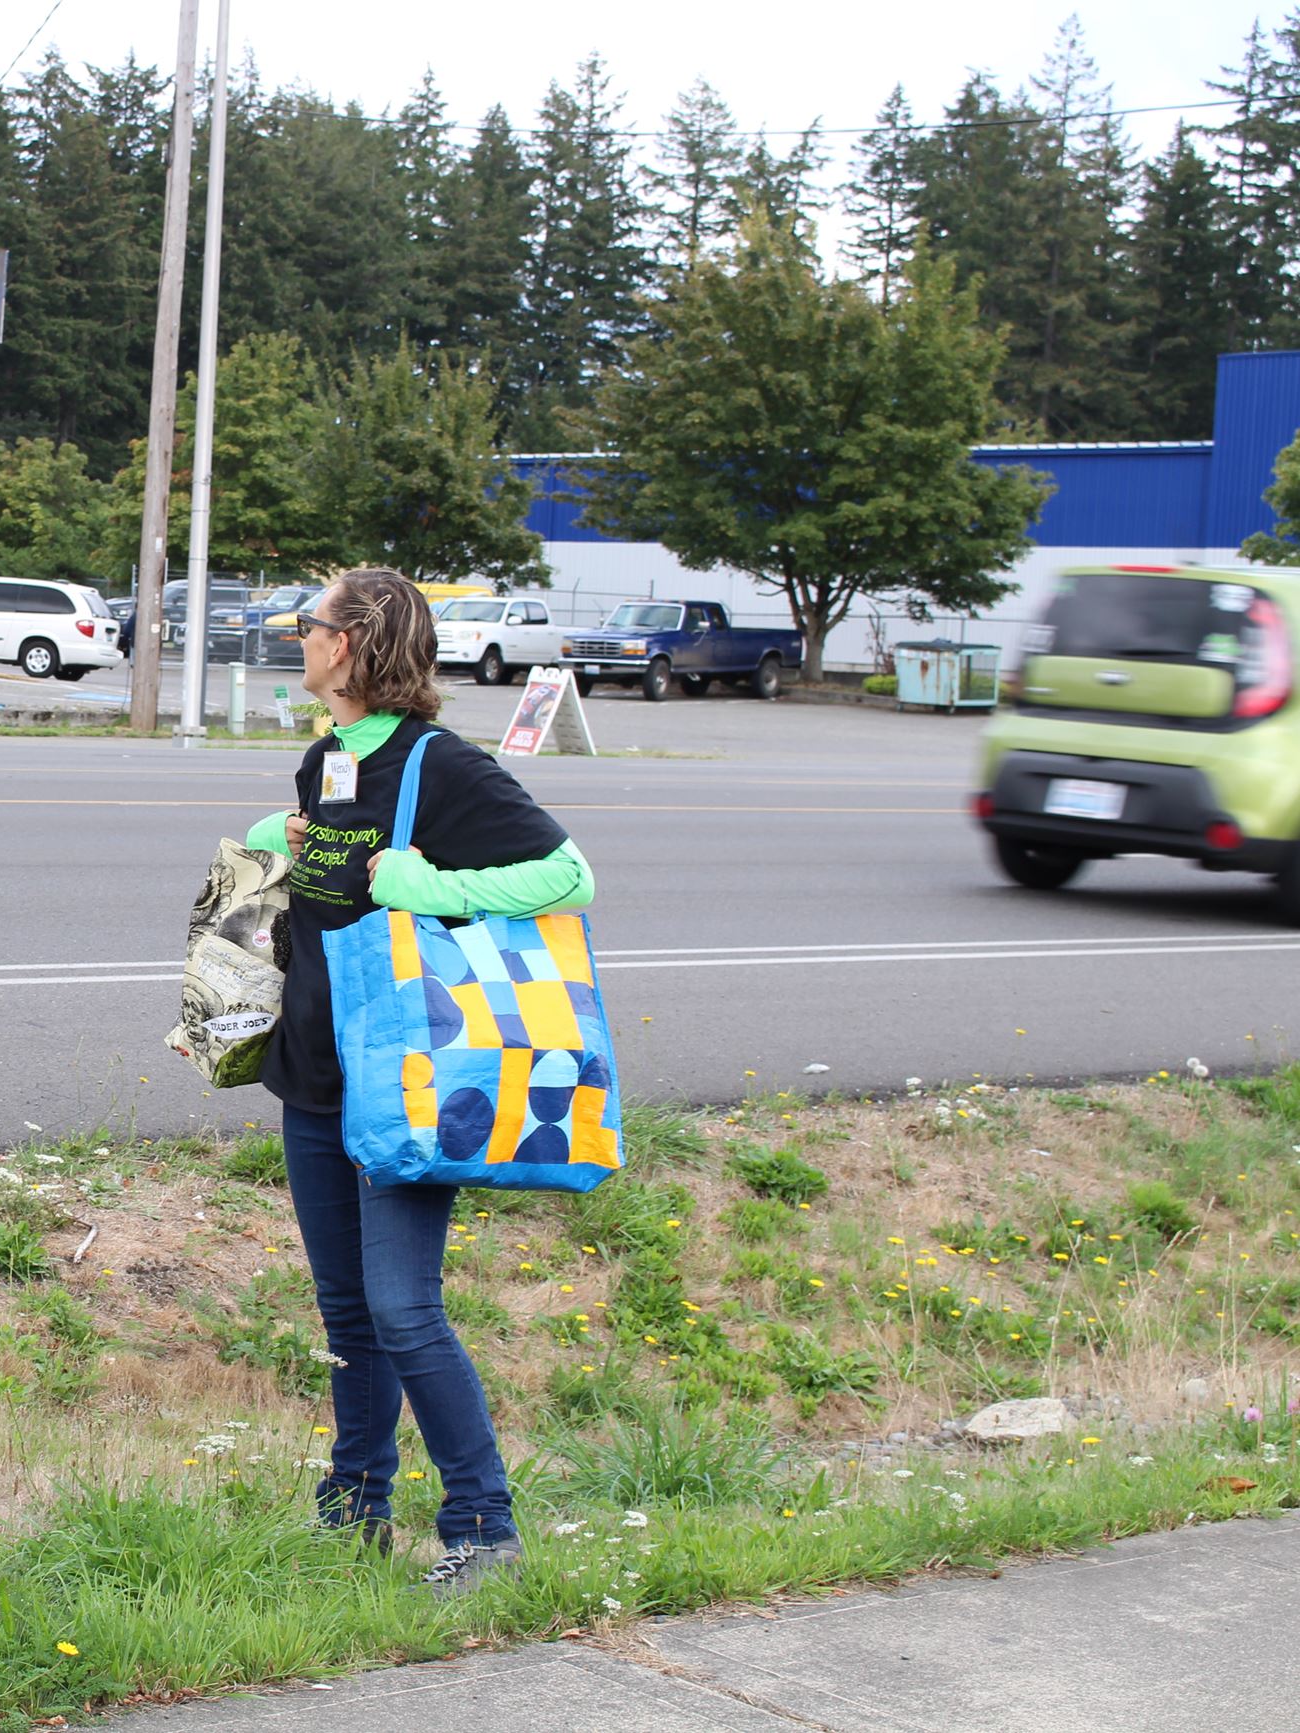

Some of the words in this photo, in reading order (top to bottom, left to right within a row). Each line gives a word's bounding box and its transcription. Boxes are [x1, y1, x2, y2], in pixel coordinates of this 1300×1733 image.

[331, 762, 350, 776] Wendy
[210, 1022, 239, 1032] TRADER
[242, 1016, 268, 1029] JOE'S
